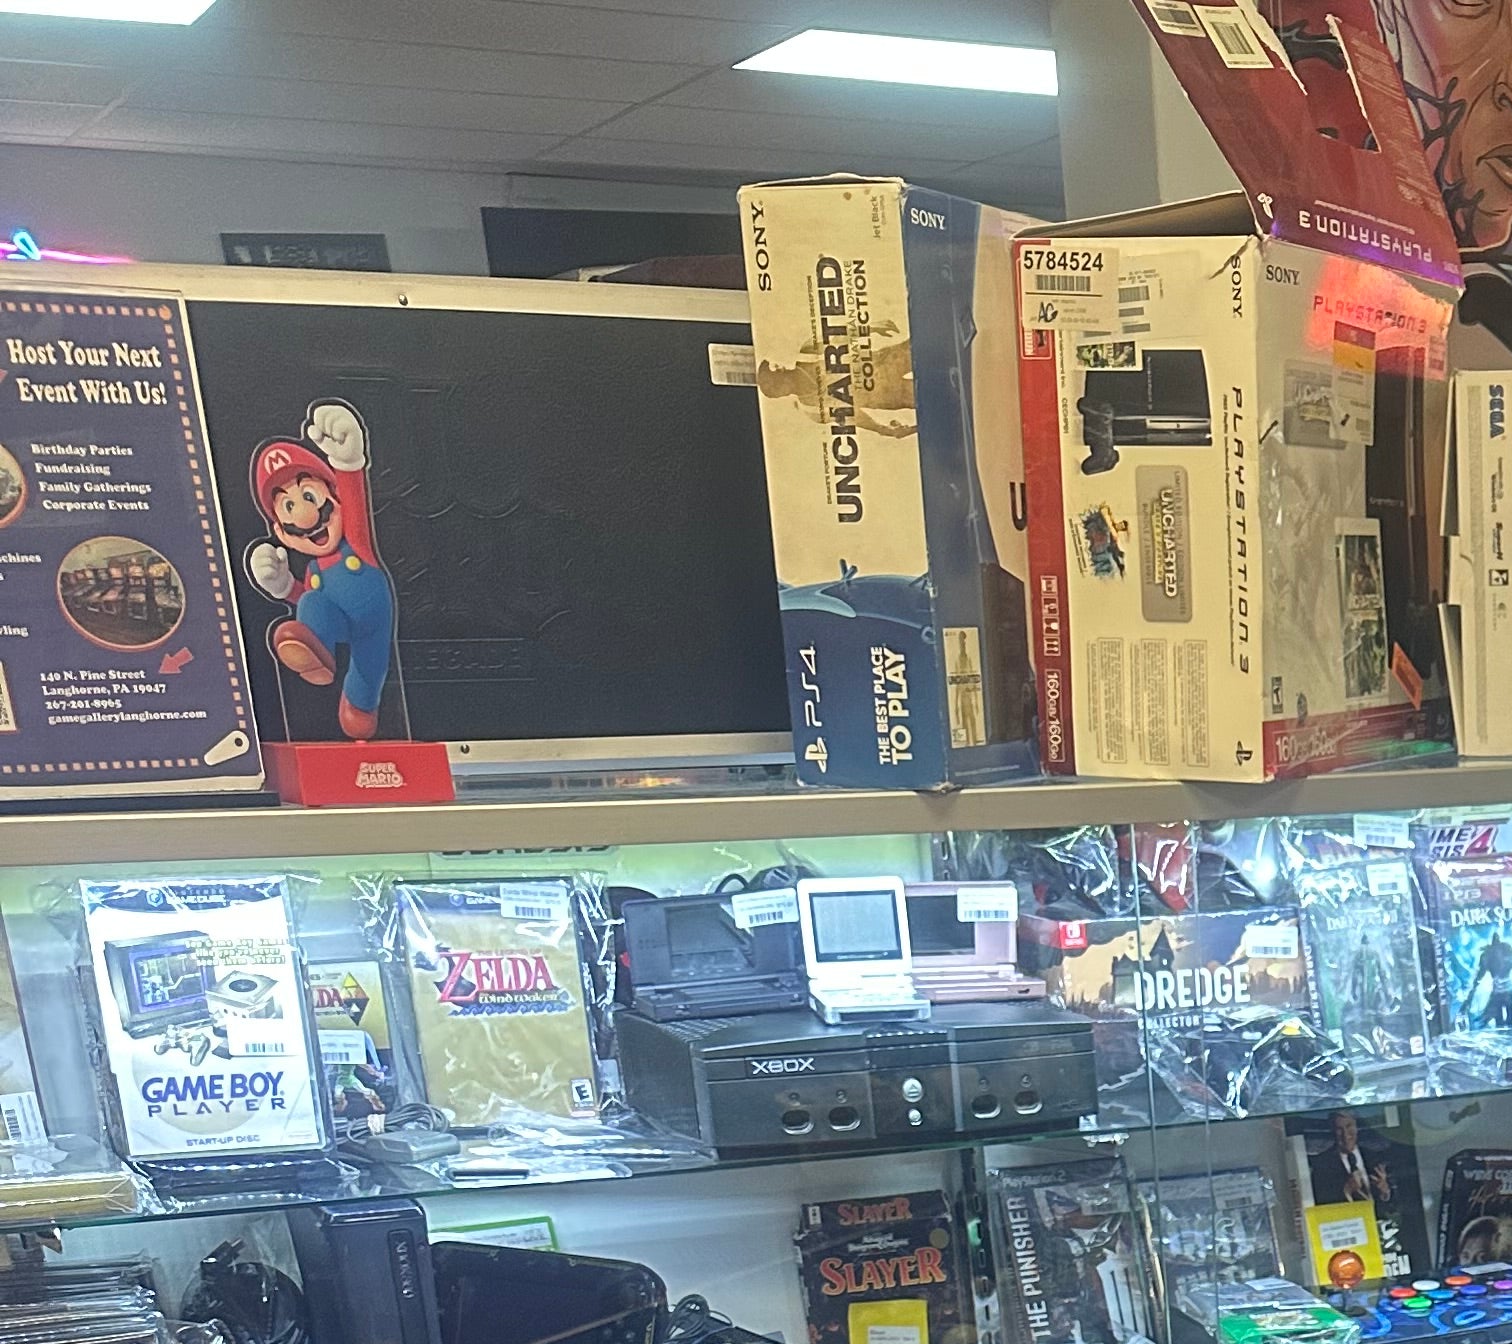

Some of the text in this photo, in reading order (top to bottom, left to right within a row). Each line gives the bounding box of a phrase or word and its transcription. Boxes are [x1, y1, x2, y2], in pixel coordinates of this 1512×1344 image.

[911, 207, 946, 230] SONY
[752, 201, 772, 292] SONY
[1299, 210, 1432, 263] PLAYSTATION 3
[1023, 250, 1104, 272] 5784524
[1266, 264, 1300, 286] SONY
[1231, 256, 1243, 318] SONY
[843, 259, 863, 391] THE NATHAN DRAKE
[852, 259, 875, 393] COLLECTION
[6, 338, 162, 368] Host Your Next
[16, 377, 168, 406] Event With Us!
[816, 256, 864, 524] UNCHARTED
[1488, 384, 1505, 439] SEGA
[30, 443, 133, 457] Birthday Parties
[34, 462, 111, 476] Fundraising
[38, 481, 152, 494] Family Gatherings
[42, 500, 150, 512] Corporate Events
[1159, 488, 1179, 598] UNCHARTED
[1231, 387, 1251, 675] PLAYSTATION 3
[0, 552, 42, 564] chines
[63, 670, 78, 681] N.
[79, 669, 106, 681] Pine
[108, 669, 146, 680] Street
[799, 646, 822, 727] PS4
[42, 683, 167, 699] Langhorne, PA 19047
[870, 646, 891, 765] THE BEST PLACE
[883, 646, 913, 765] TO PLAY
[48, 709, 207, 725] gamegallerylanghorne.com
[356, 773, 403, 788] MARIO
[1450, 908, 1490, 928] DARK
[438, 952, 558, 1004] ZELDA
[1133, 963, 1251, 1011] DREDGE
[751, 1057, 816, 1075] XBOX
[142, 1072, 285, 1103] GAME BOY
[575, 1085, 590, 1101] E
[148, 1097, 287, 1118] PLAYER
[186, 1134, 261, 1147] START-UP DISC
[837, 1197, 912, 1226] SLAYER
[819, 1246, 947, 1296] SLAYER
[1006, 1196, 1051, 1338] THE PUNISHER
